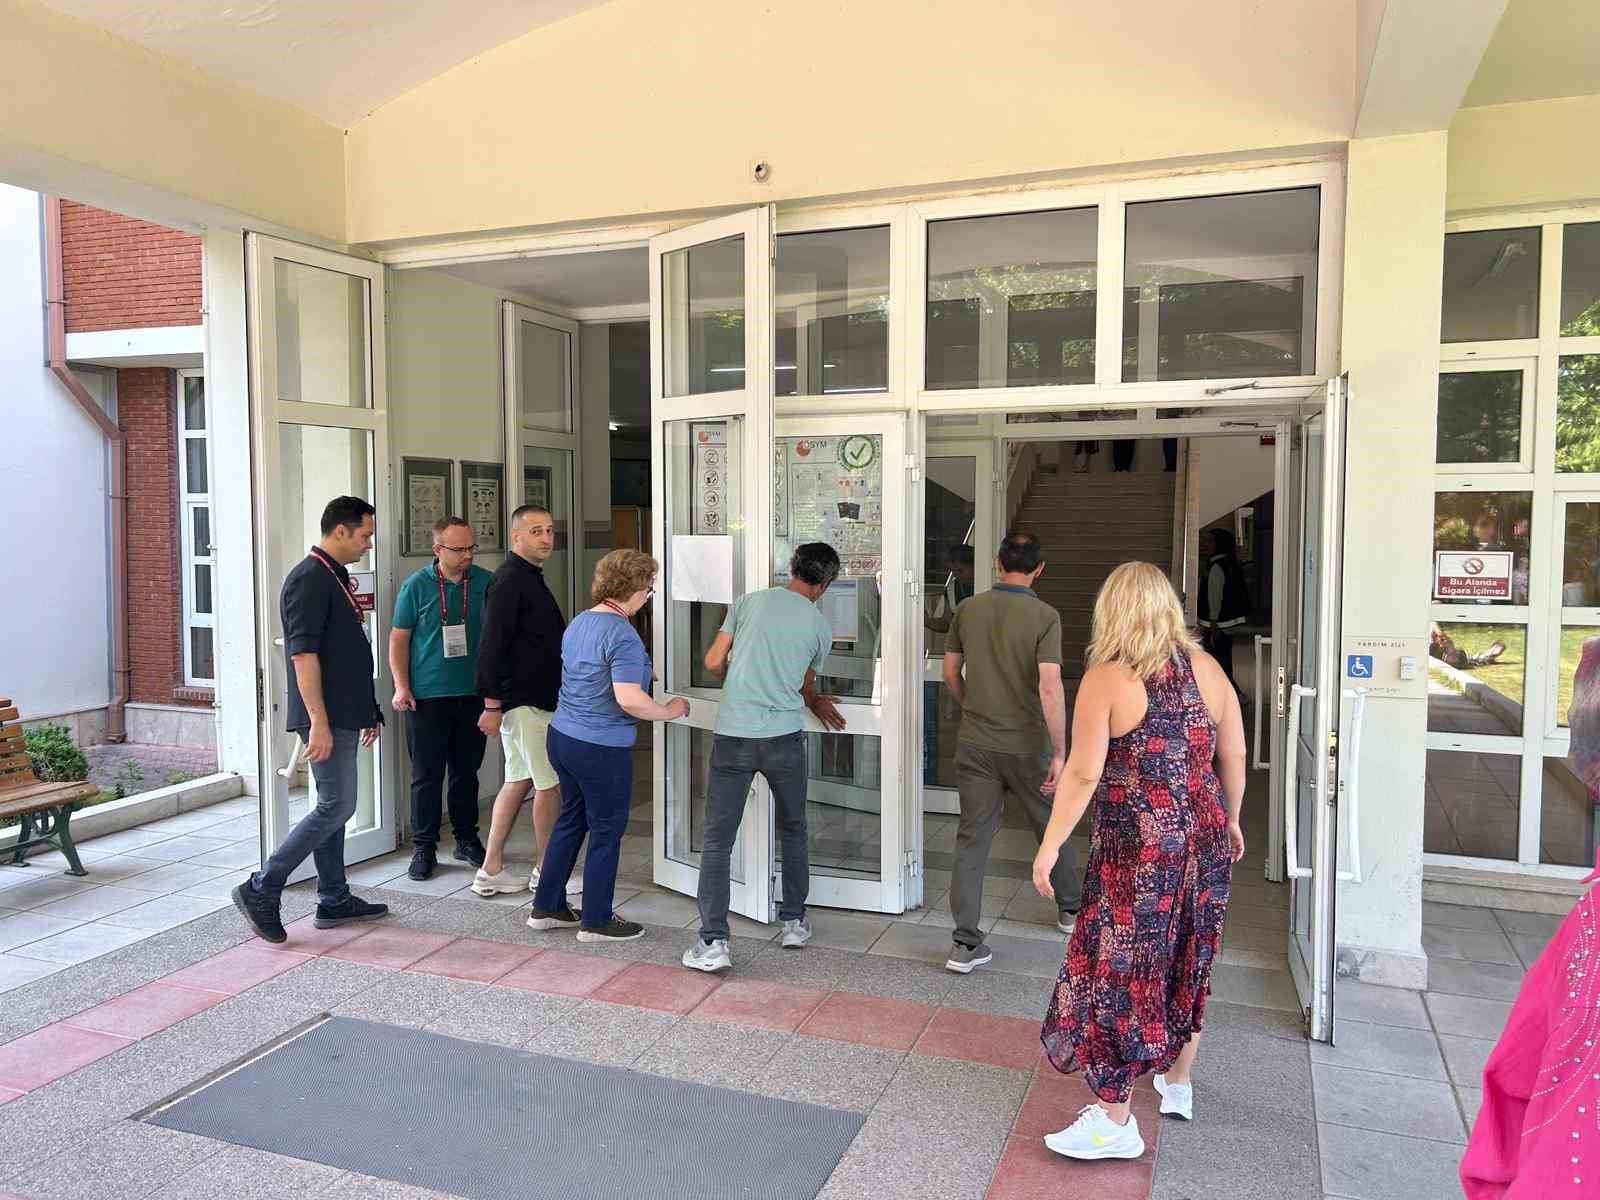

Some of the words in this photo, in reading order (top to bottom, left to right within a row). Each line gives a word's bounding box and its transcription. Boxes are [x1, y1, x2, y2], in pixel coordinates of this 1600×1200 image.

[1449, 578, 1462, 586] Bu
[1465, 578, 1497, 587] Alanda
[1441, 586, 1471, 595] Sigara
